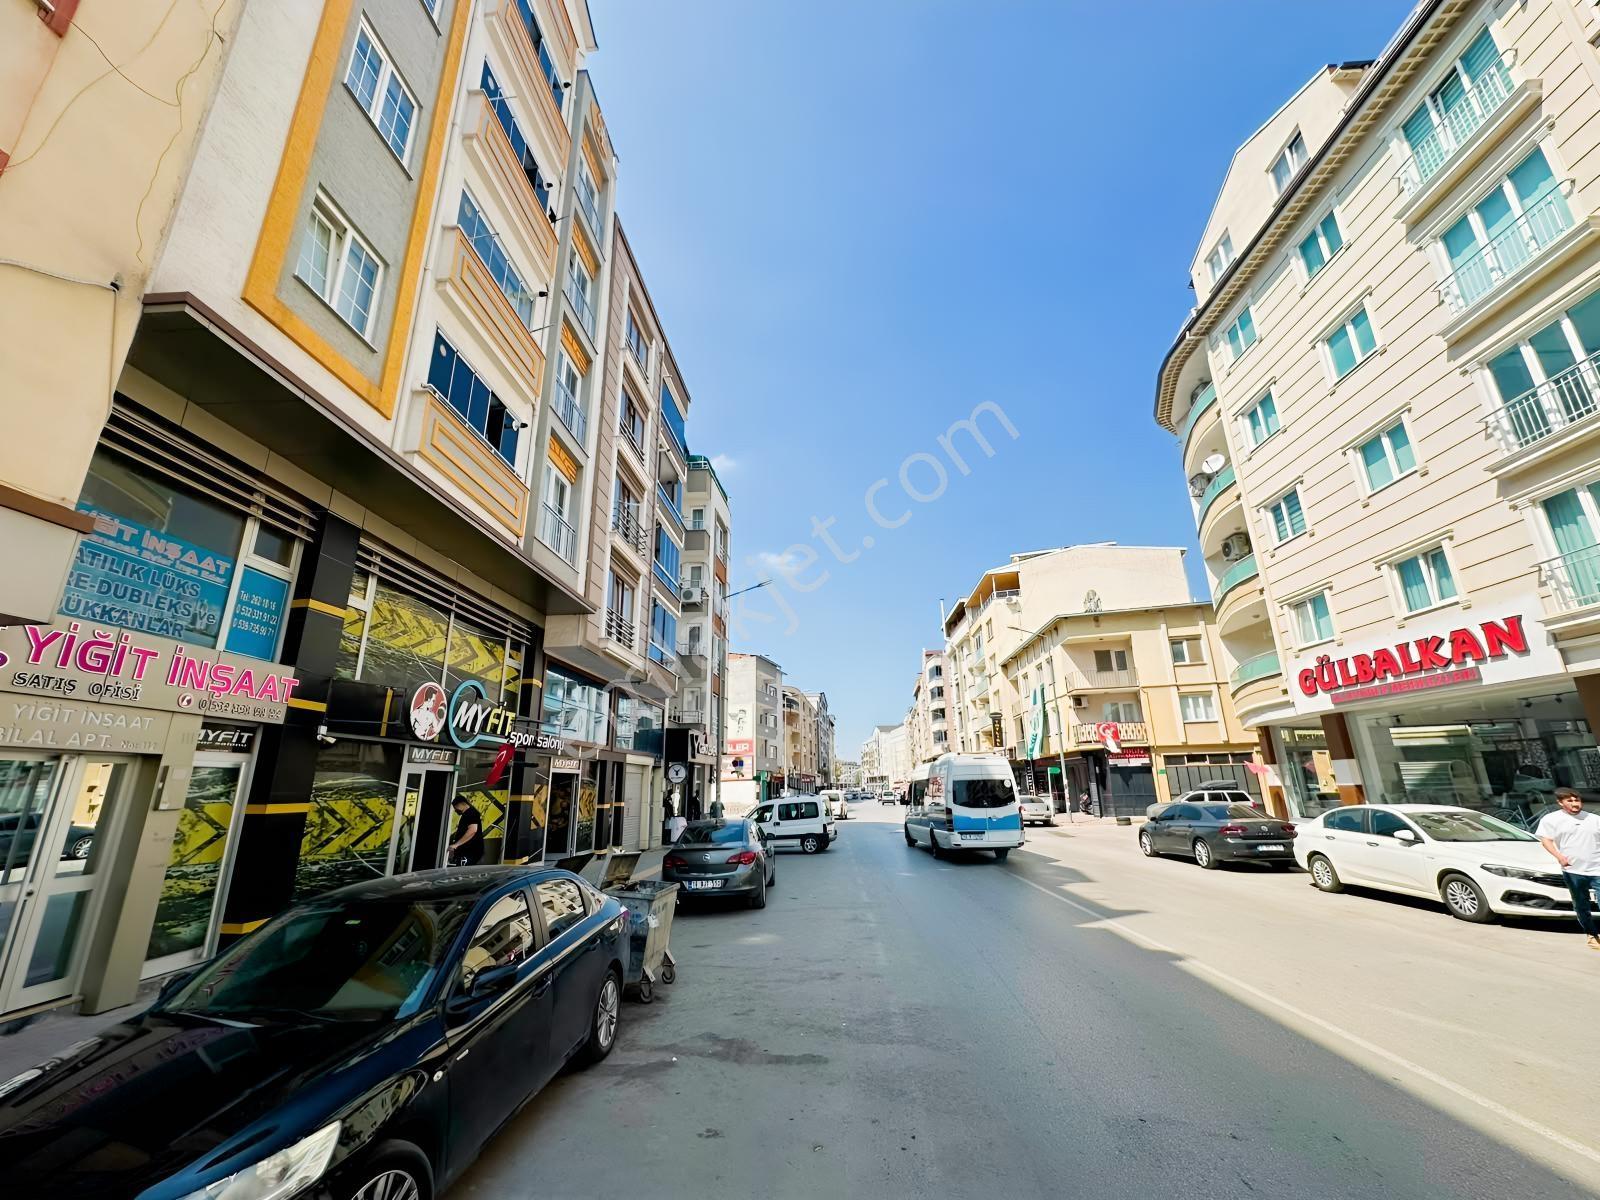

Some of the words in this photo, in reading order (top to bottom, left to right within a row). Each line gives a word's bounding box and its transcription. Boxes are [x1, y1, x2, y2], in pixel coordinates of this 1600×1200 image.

[149, 569, 201, 598] LÜKS
[199, 610, 217, 625] ve
[24, 621, 159, 681] YİĞİT
[166, 644, 300, 704] İNŞAAT
[1298, 615, 1526, 695] GÜLBALKAN
[12, 672, 78, 696] SATIŞ
[88, 681, 142, 701] OFİSİ
[65, 732, 112, 748] APT.
[510, 732, 534, 748] spor
